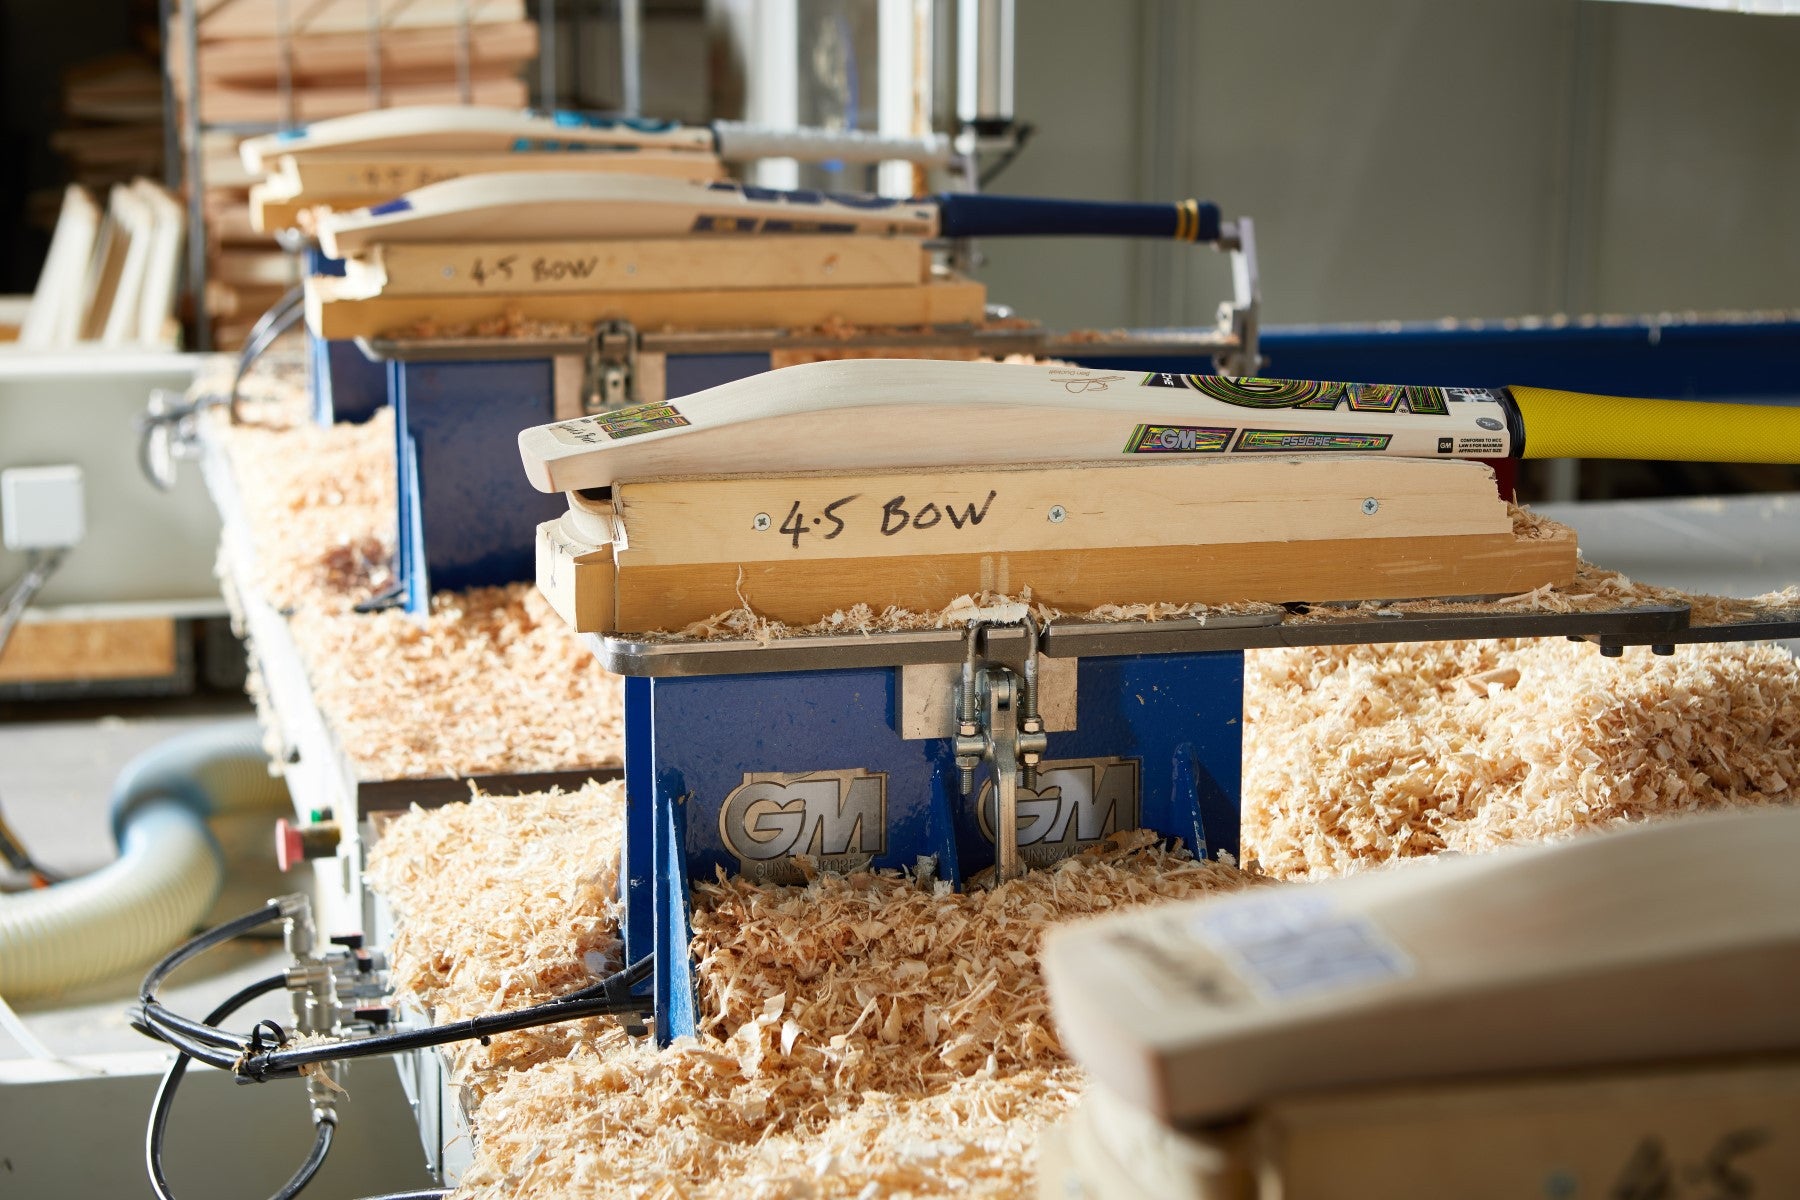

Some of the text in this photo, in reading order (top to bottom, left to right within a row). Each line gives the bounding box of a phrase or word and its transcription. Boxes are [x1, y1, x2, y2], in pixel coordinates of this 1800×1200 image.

[531, 255, 599, 283] BOW
[1160, 429, 1332, 450] GM PSYCHE
[880, 489, 997, 536] BOW
[725, 776, 883, 861] GM
[982, 762, 1137, 848] GM
